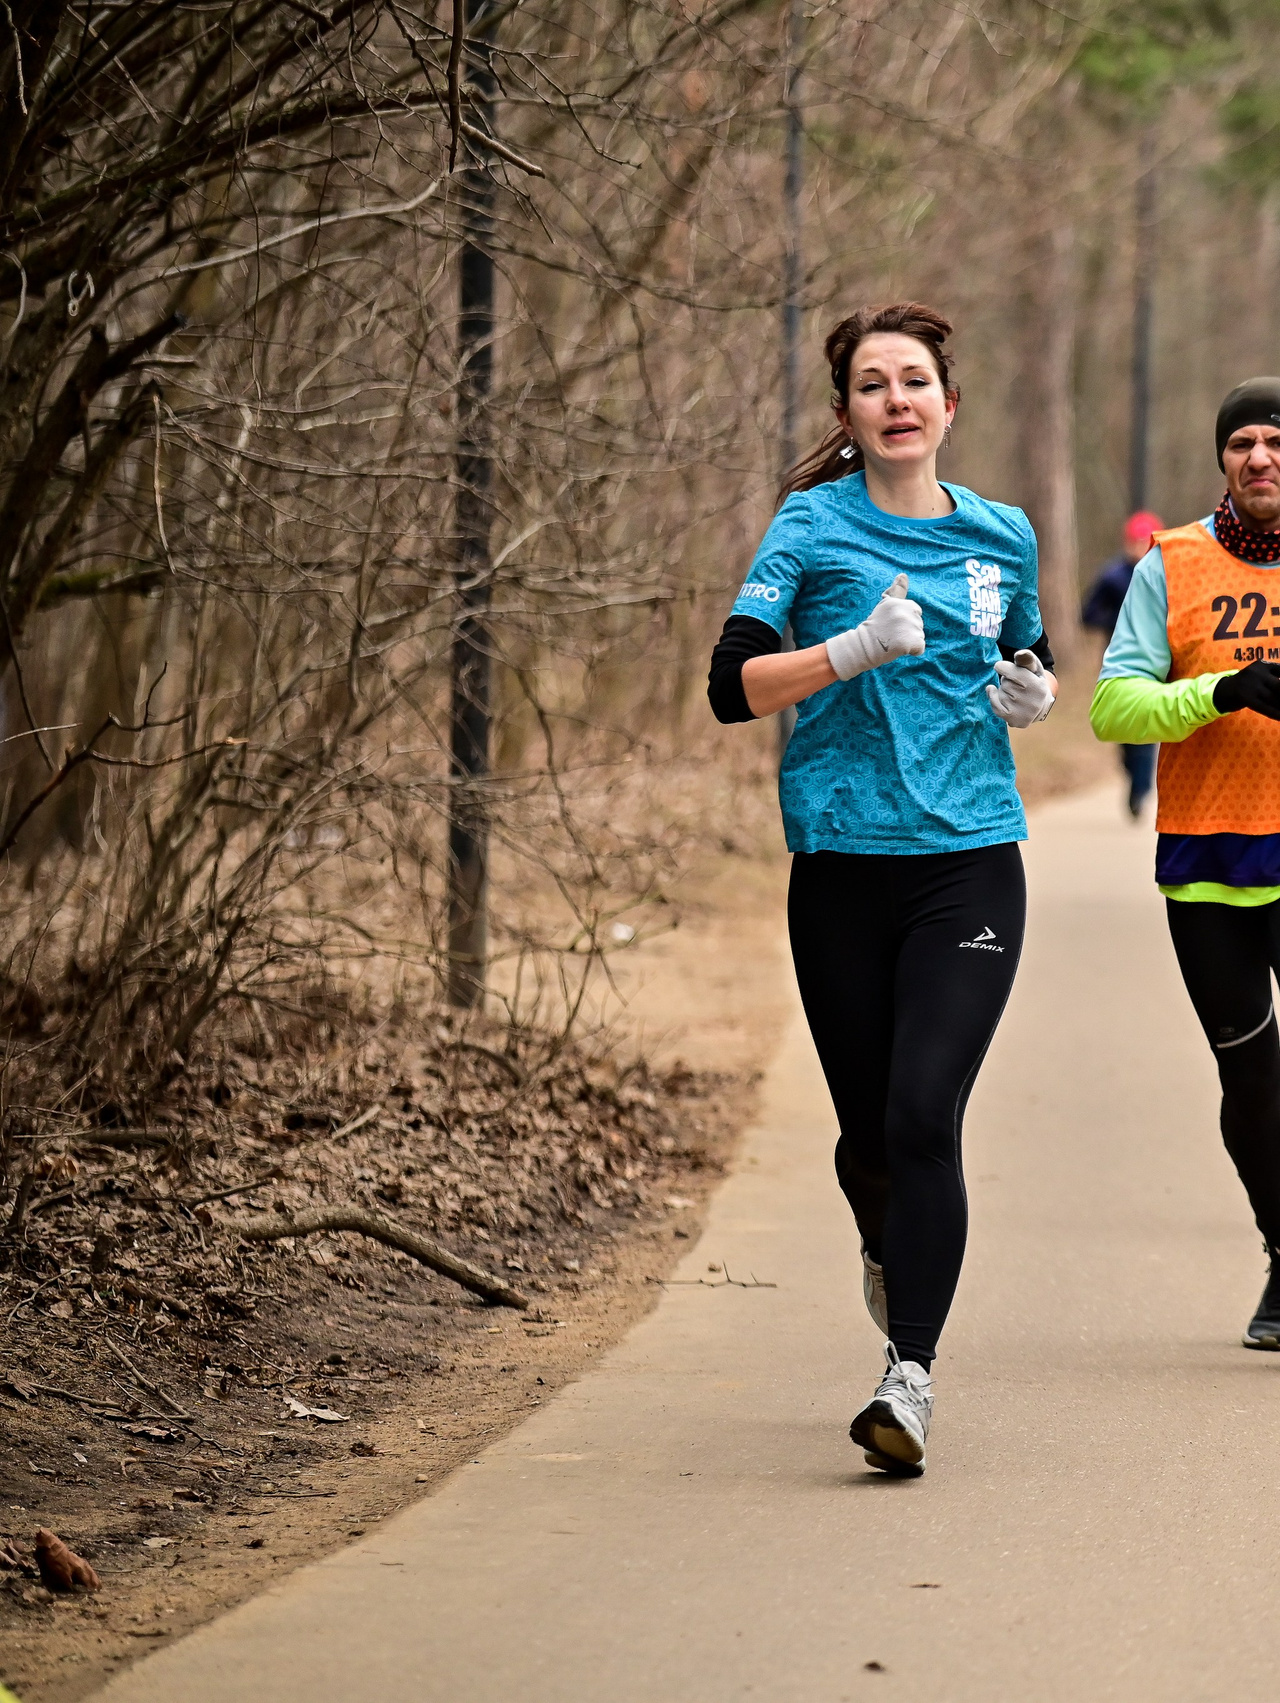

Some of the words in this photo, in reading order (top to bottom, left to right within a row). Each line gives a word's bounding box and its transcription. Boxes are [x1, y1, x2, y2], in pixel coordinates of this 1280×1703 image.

[969, 586, 1001, 616] 9AM
[1233, 646, 1264, 662] 4:30
[958, 941, 1005, 953] DEMIX
